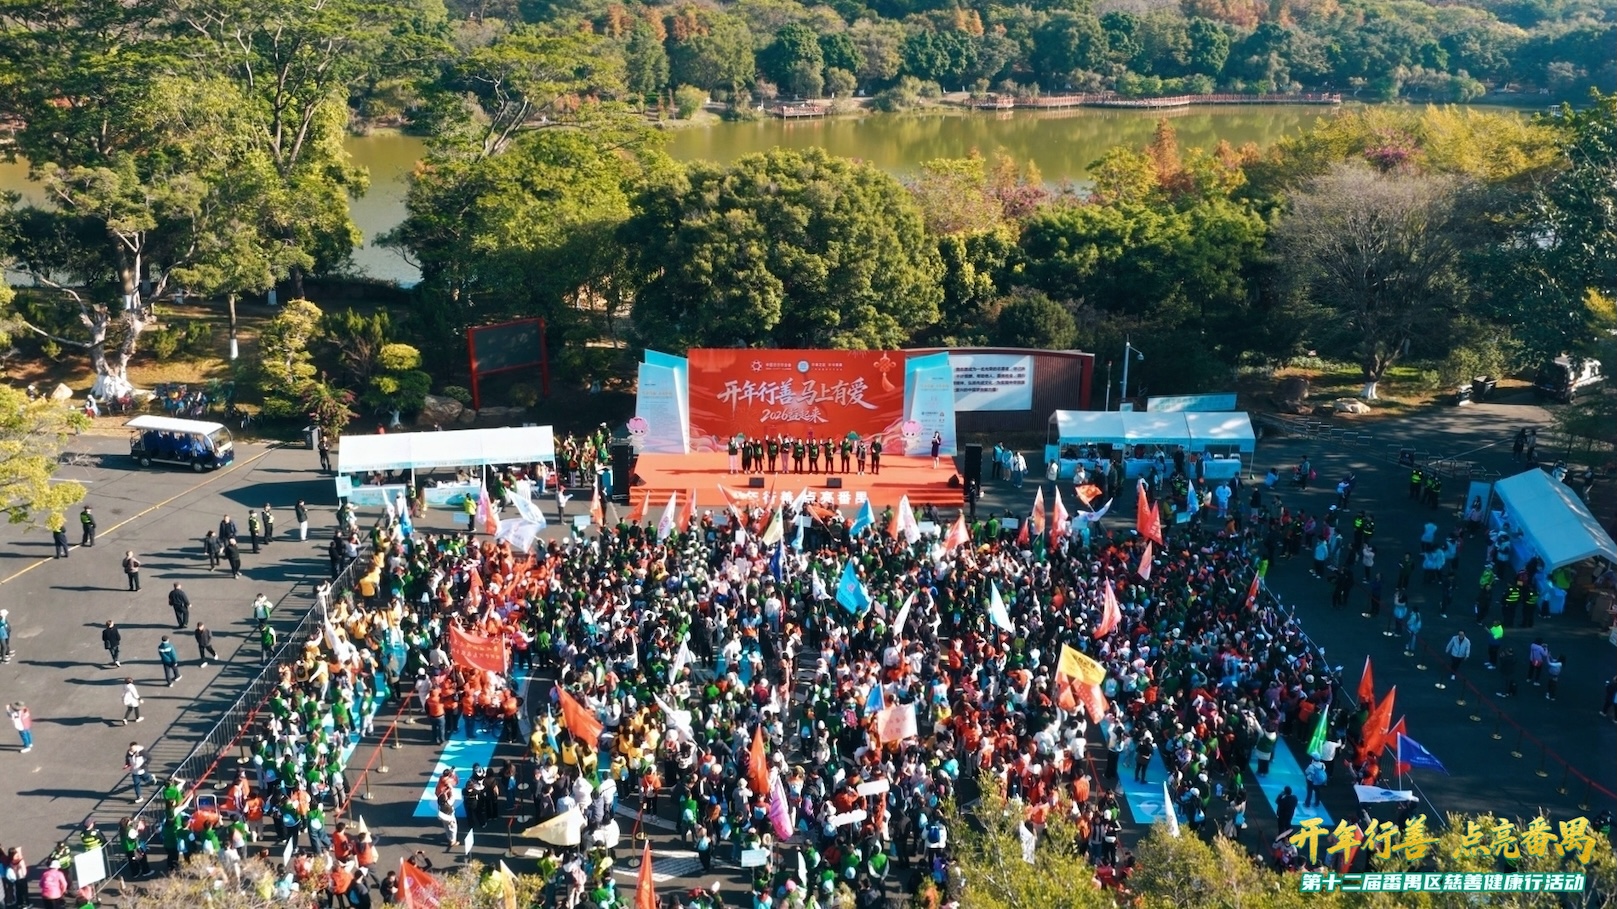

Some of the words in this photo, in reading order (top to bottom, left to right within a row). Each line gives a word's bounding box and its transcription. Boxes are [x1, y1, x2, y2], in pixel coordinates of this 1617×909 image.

[717, 377, 796, 415] 开年行善
[797, 376, 880, 410] 马上有爱
[760, 406, 829, 423] 2026益起来
[734, 490, 794, 505] 年行善
[803, 490, 868, 505] 点亮番禺
